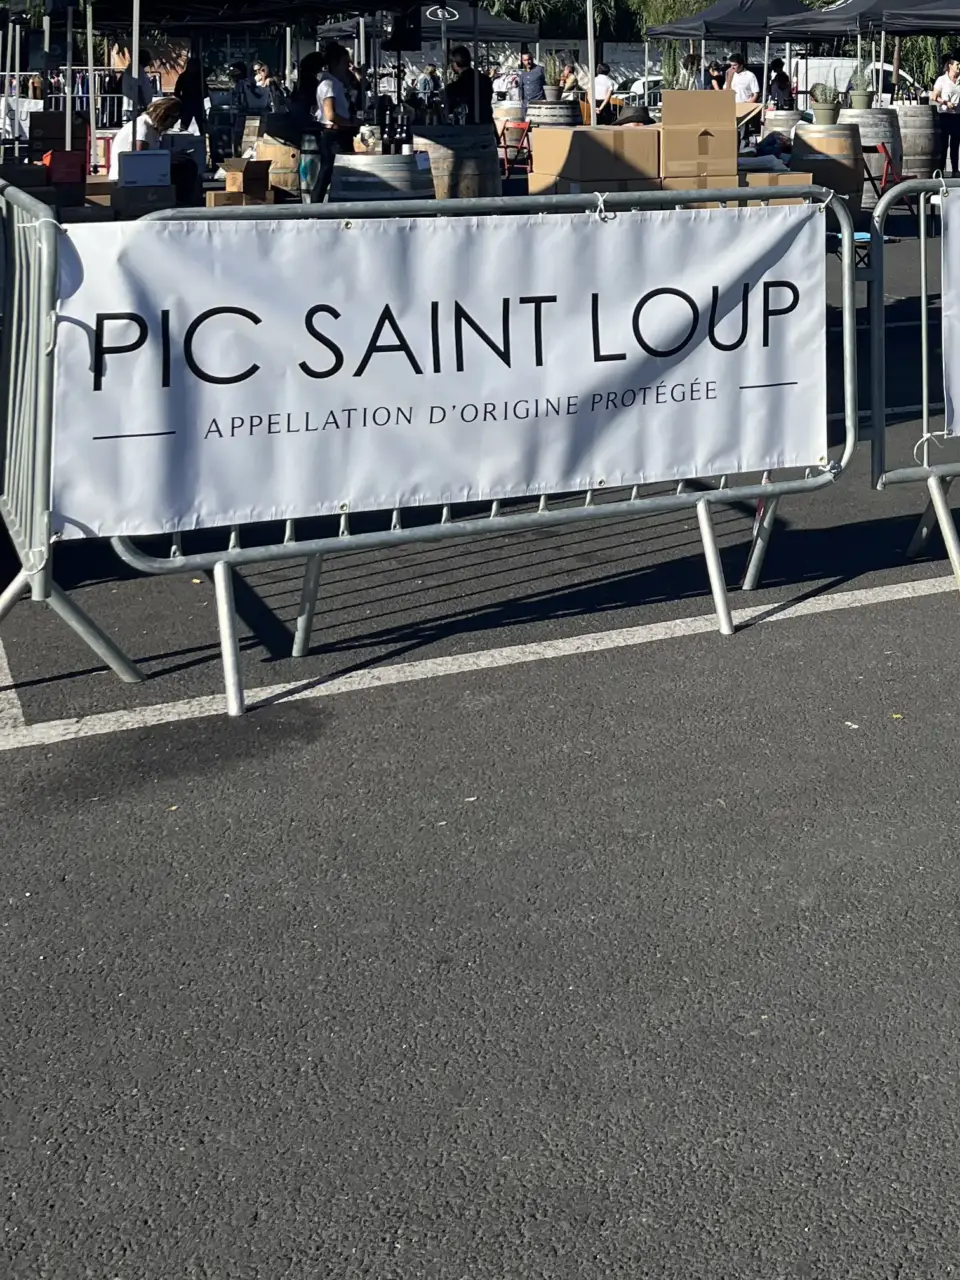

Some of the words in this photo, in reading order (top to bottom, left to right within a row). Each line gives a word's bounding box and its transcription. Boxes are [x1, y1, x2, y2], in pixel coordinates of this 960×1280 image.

[92, 306, 262, 391] PIC
[298, 295, 557, 379] SAINT
[591, 280, 801, 362] LOUP
[204, 406, 414, 440] APPELLATION
[591, 378, 718, 412] PROTÉGÉE
